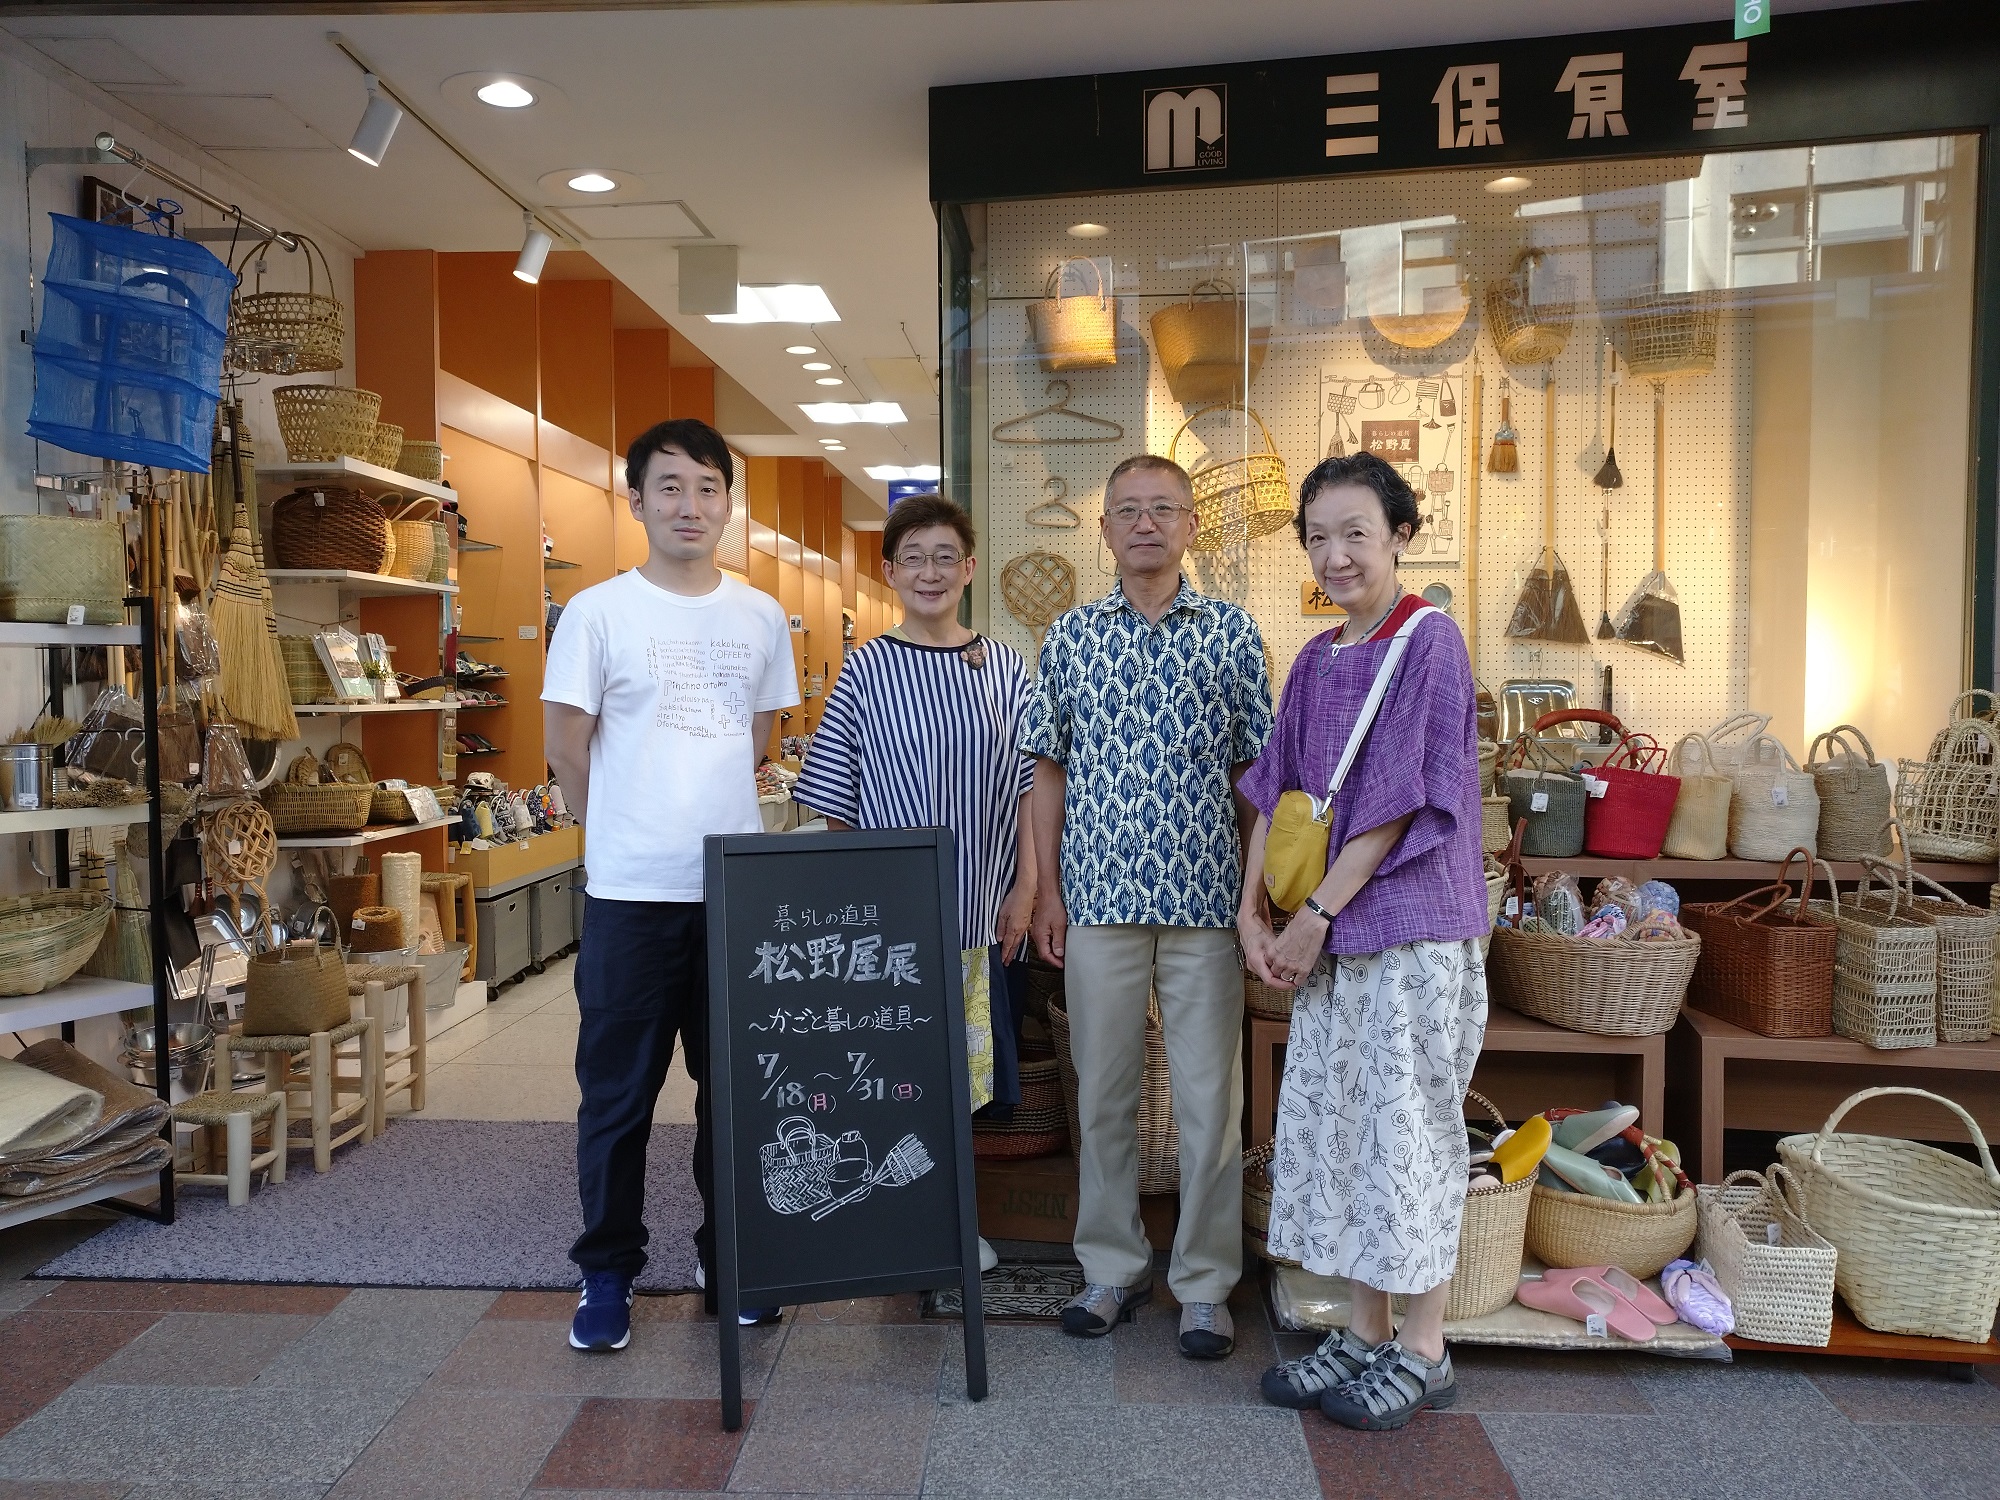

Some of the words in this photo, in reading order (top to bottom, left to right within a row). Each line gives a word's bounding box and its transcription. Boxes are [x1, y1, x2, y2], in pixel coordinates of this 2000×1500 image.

[1325, 41, 1749, 157] 三保原屋
[1197, 157, 1224, 167] LIVING
[1199, 150, 1222, 159] GOOD
[1370, 438, 1412, 451] 松野屋
[1307, 586, 1334, 611] 松
[709, 648, 742, 661] COFFEE
[773, 904, 881, 932] 暮らしの道具
[748, 933, 922, 987] 松野屋展
